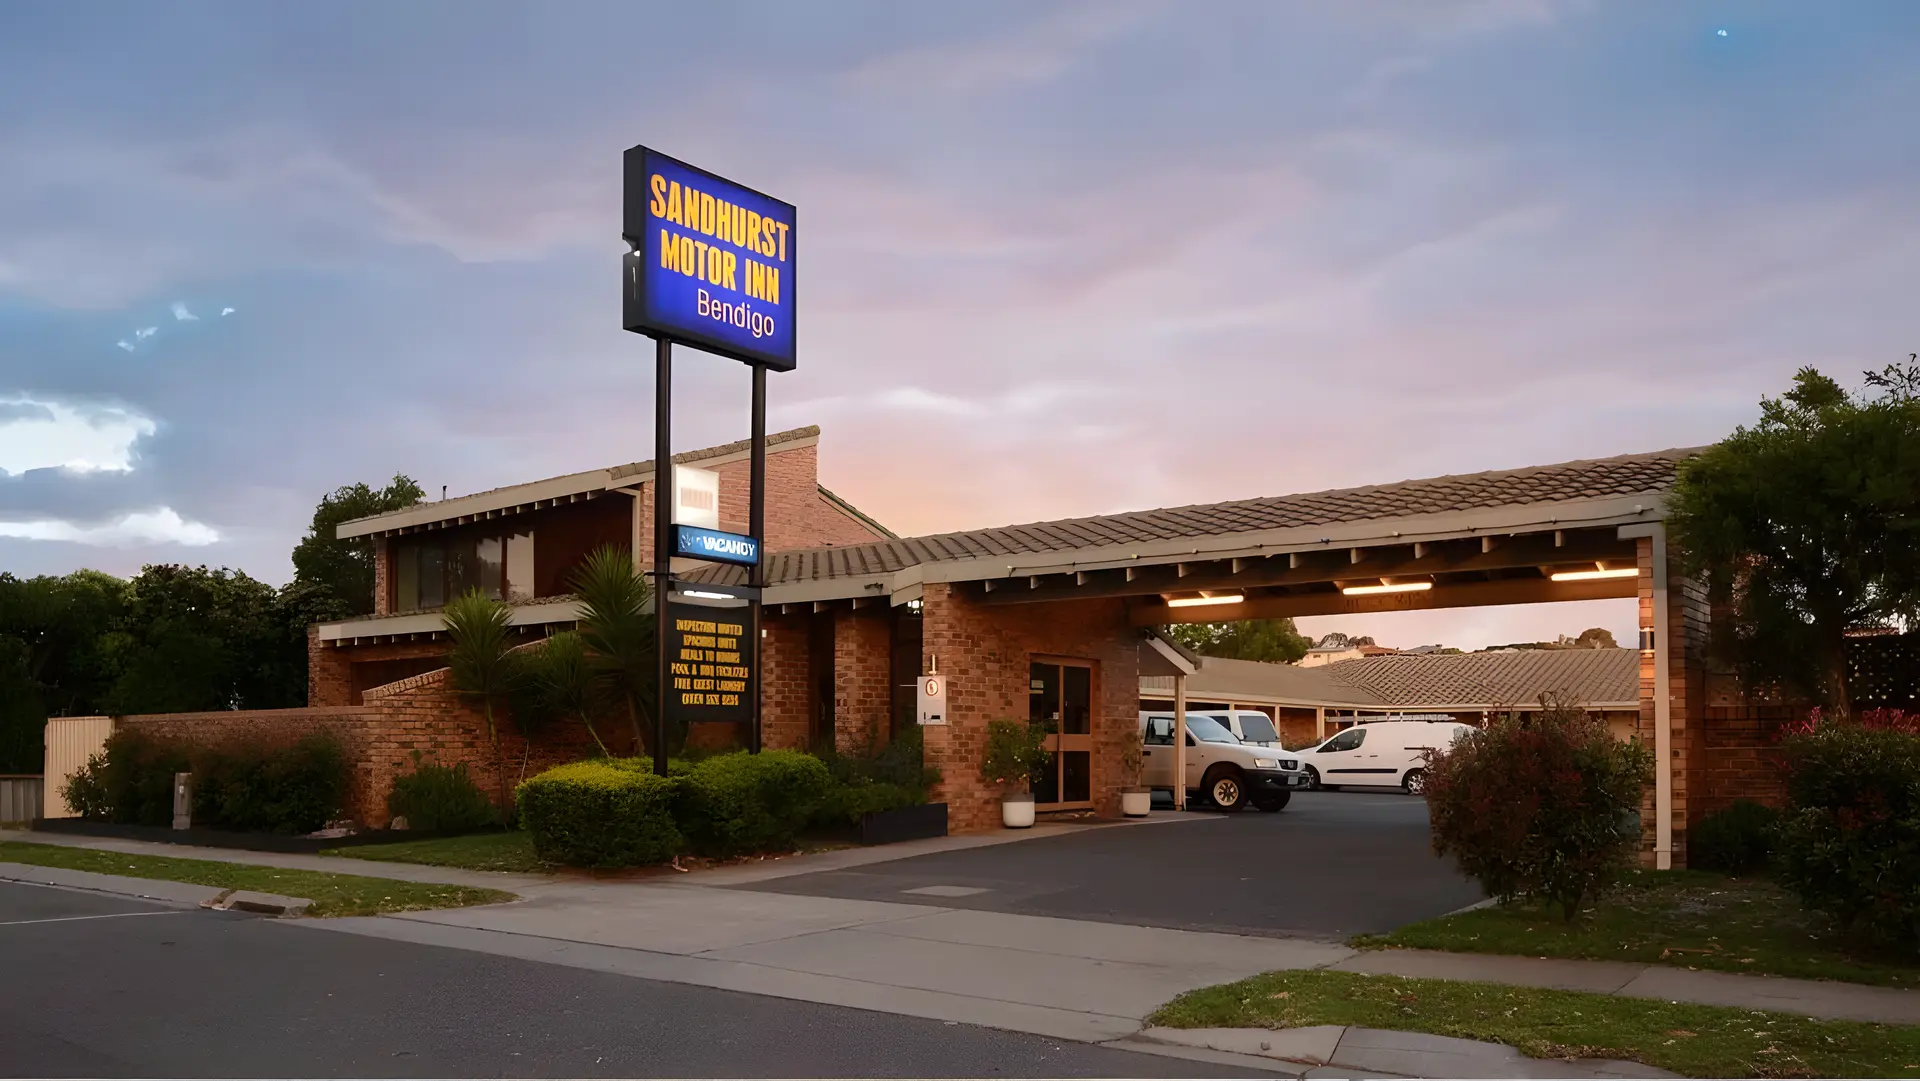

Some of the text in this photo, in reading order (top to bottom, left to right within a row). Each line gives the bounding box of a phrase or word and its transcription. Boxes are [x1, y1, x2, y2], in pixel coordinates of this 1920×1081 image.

[650, 174, 789, 262] SANDHURST
[661, 229, 780, 305] MOTOR INN
[697, 288, 774, 338] Bendigo
